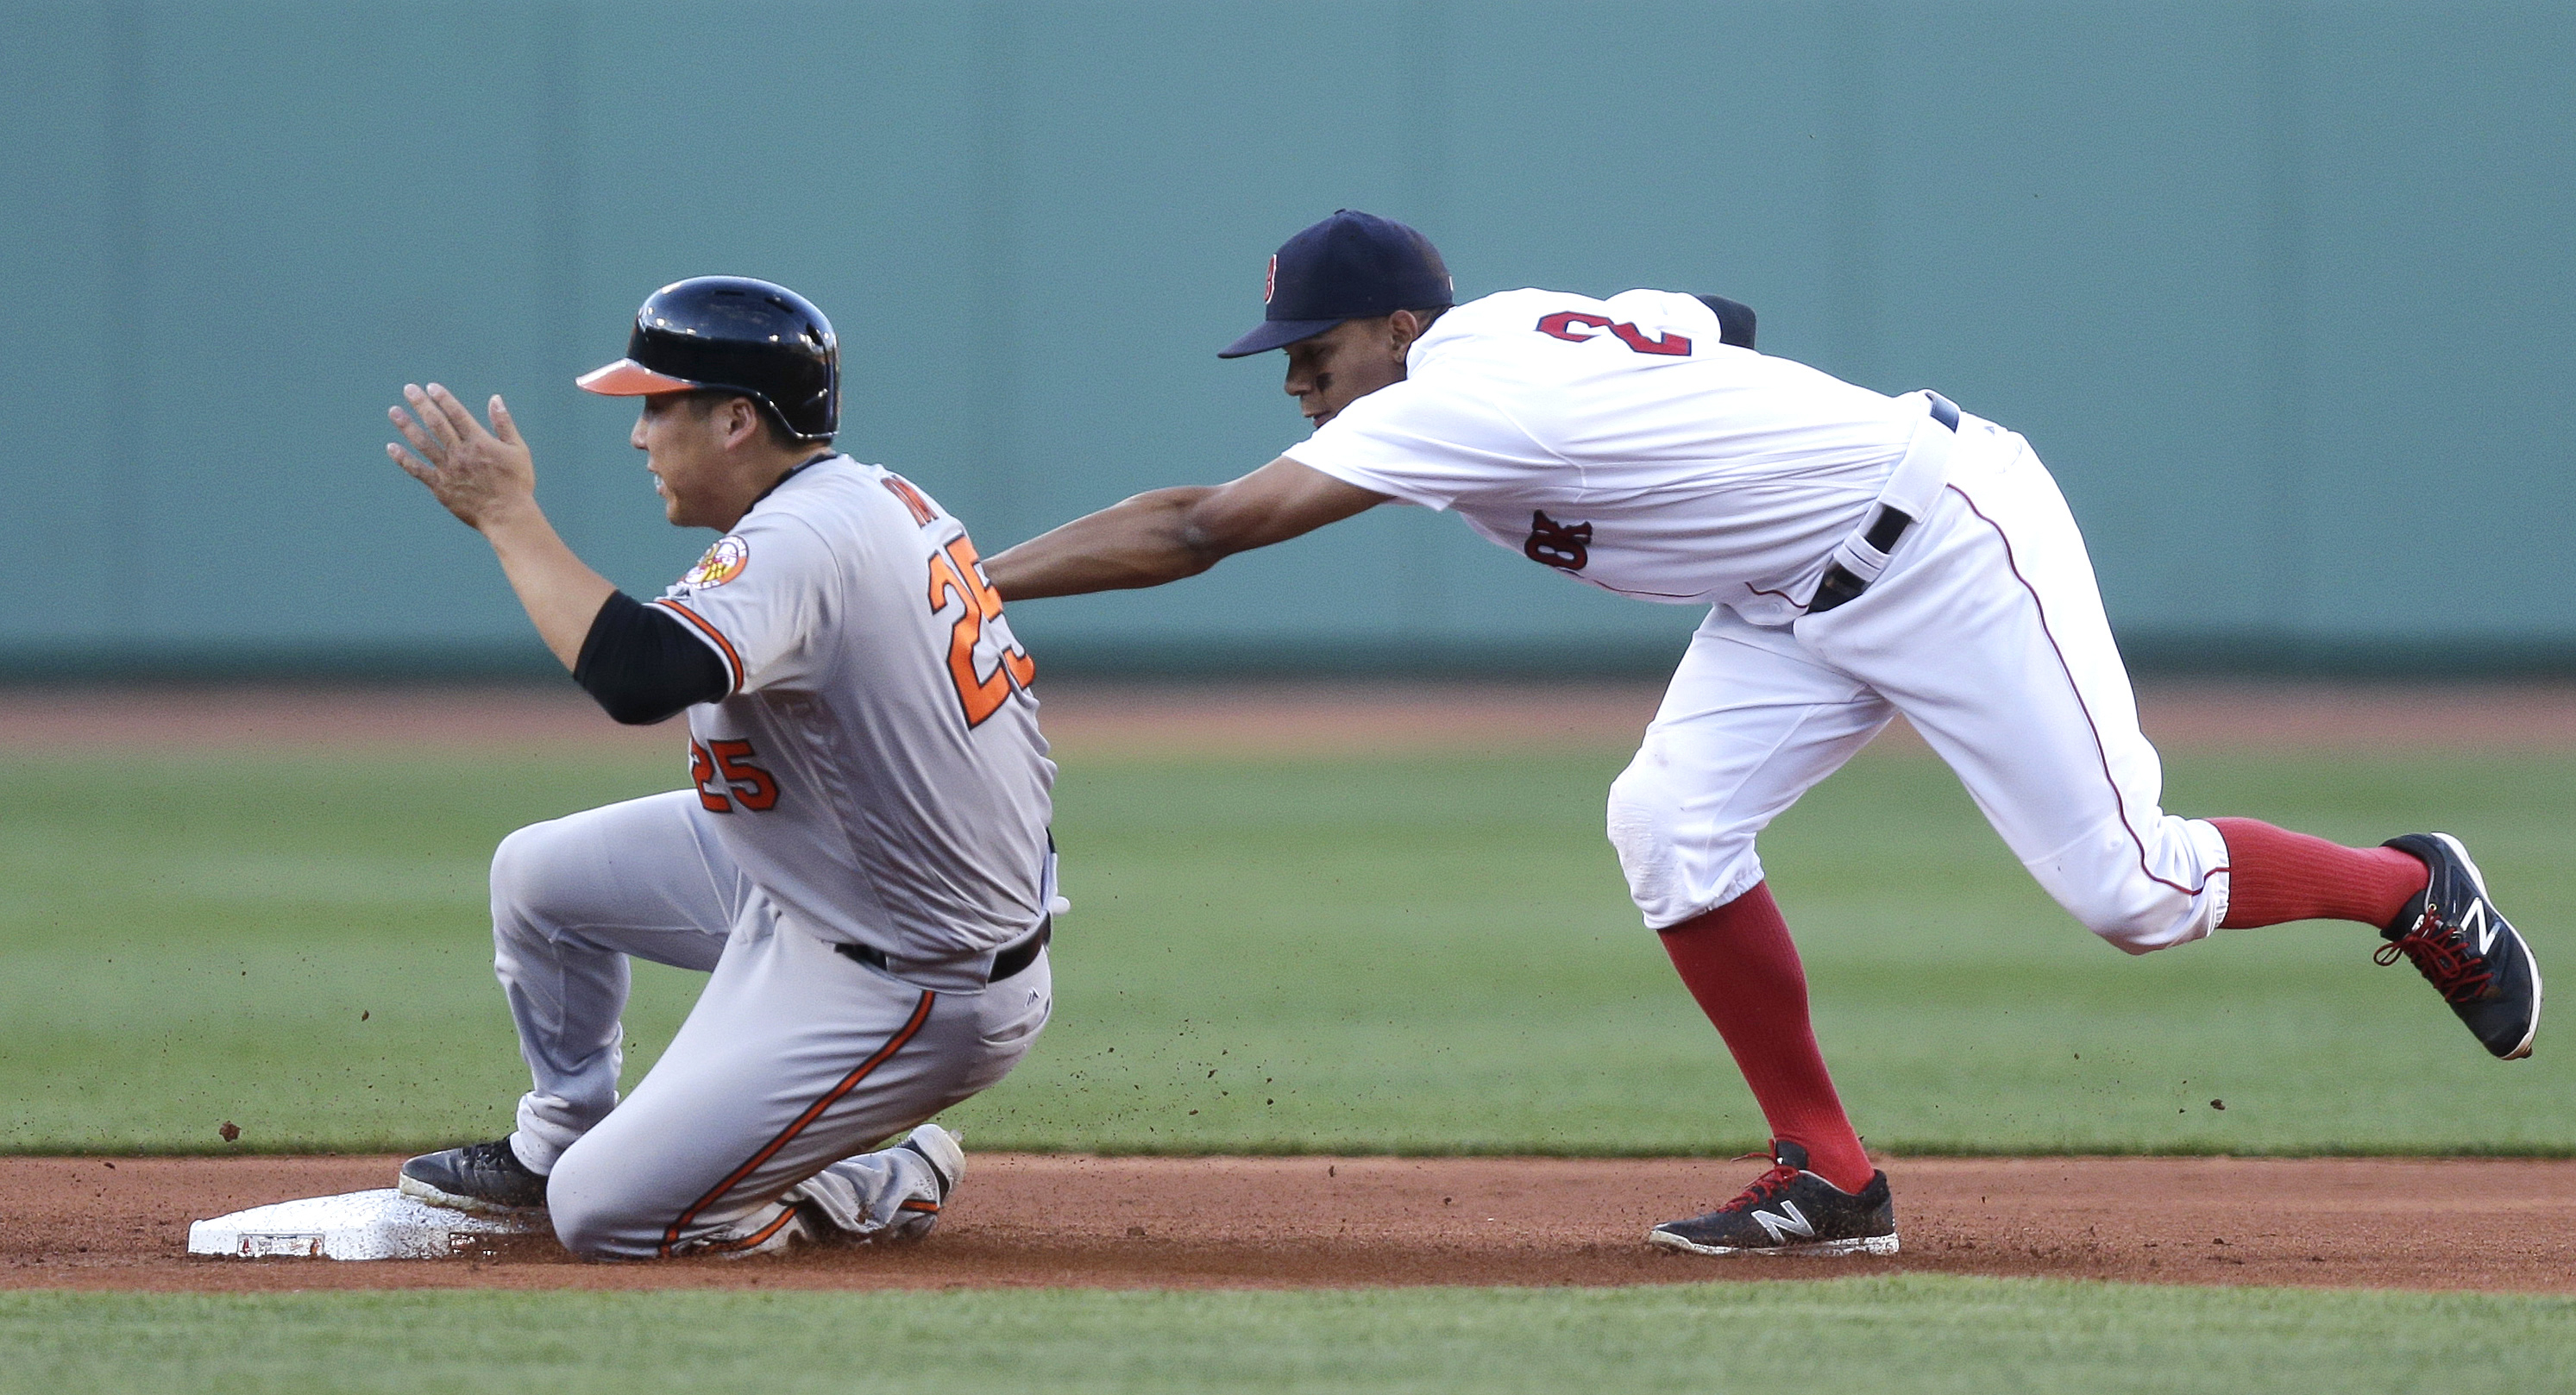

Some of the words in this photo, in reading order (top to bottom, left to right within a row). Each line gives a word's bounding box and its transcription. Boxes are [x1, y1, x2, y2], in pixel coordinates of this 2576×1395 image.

[1534, 311, 1692, 357] 2
[927, 532, 1035, 732] 25
[690, 738, 781, 814] 25
